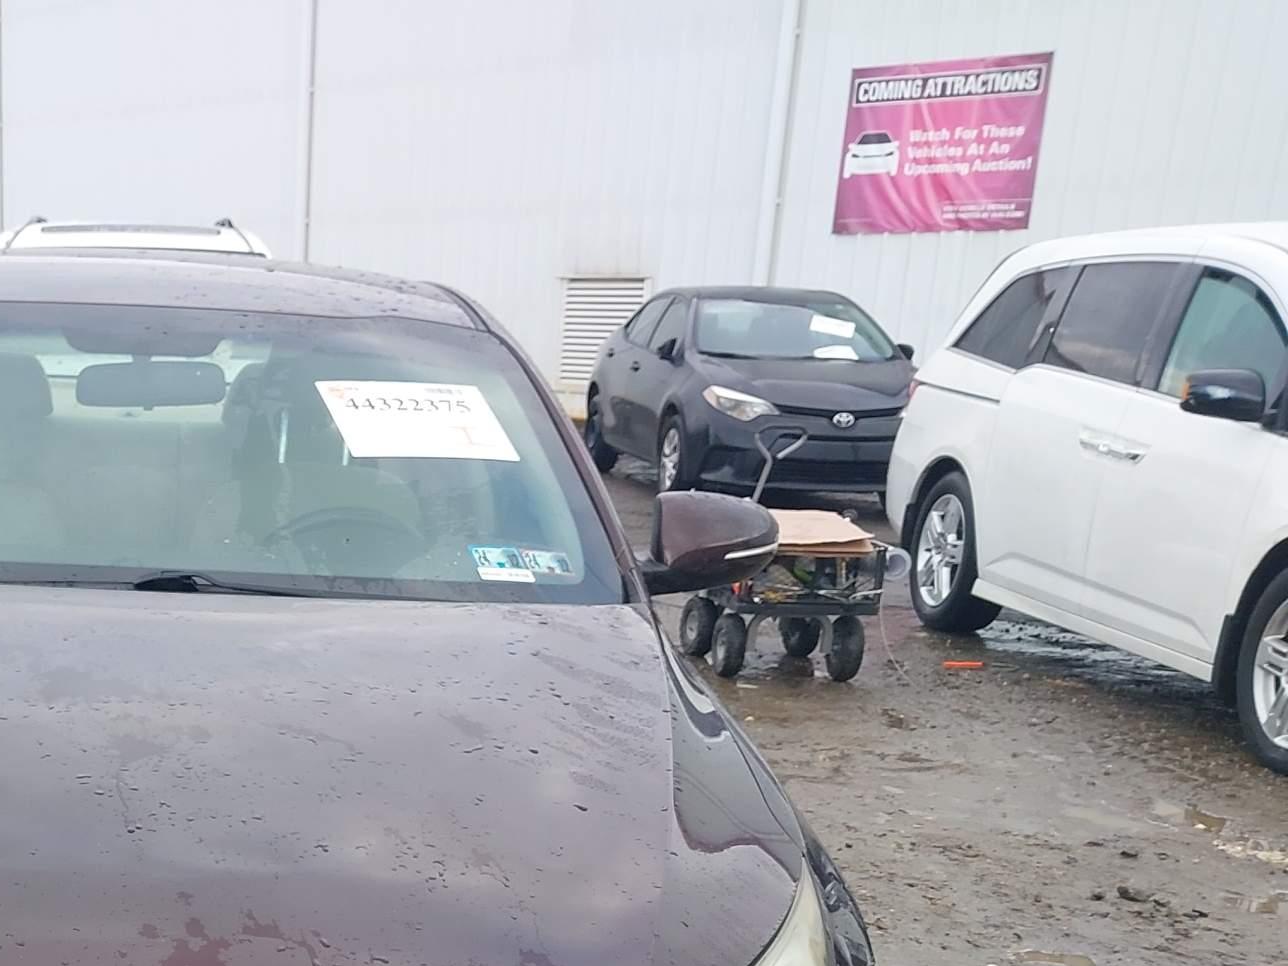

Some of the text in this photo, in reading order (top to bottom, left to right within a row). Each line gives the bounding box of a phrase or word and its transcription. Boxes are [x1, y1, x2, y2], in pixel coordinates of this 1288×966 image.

[858, 69, 1039, 102] COMING ATTRACTIONS
[909, 124, 1025, 142] Watch For These
[988, 141, 1010, 155] An
[904, 162, 970, 176] Upcoming
[345, 398, 471, 413] 44322375
